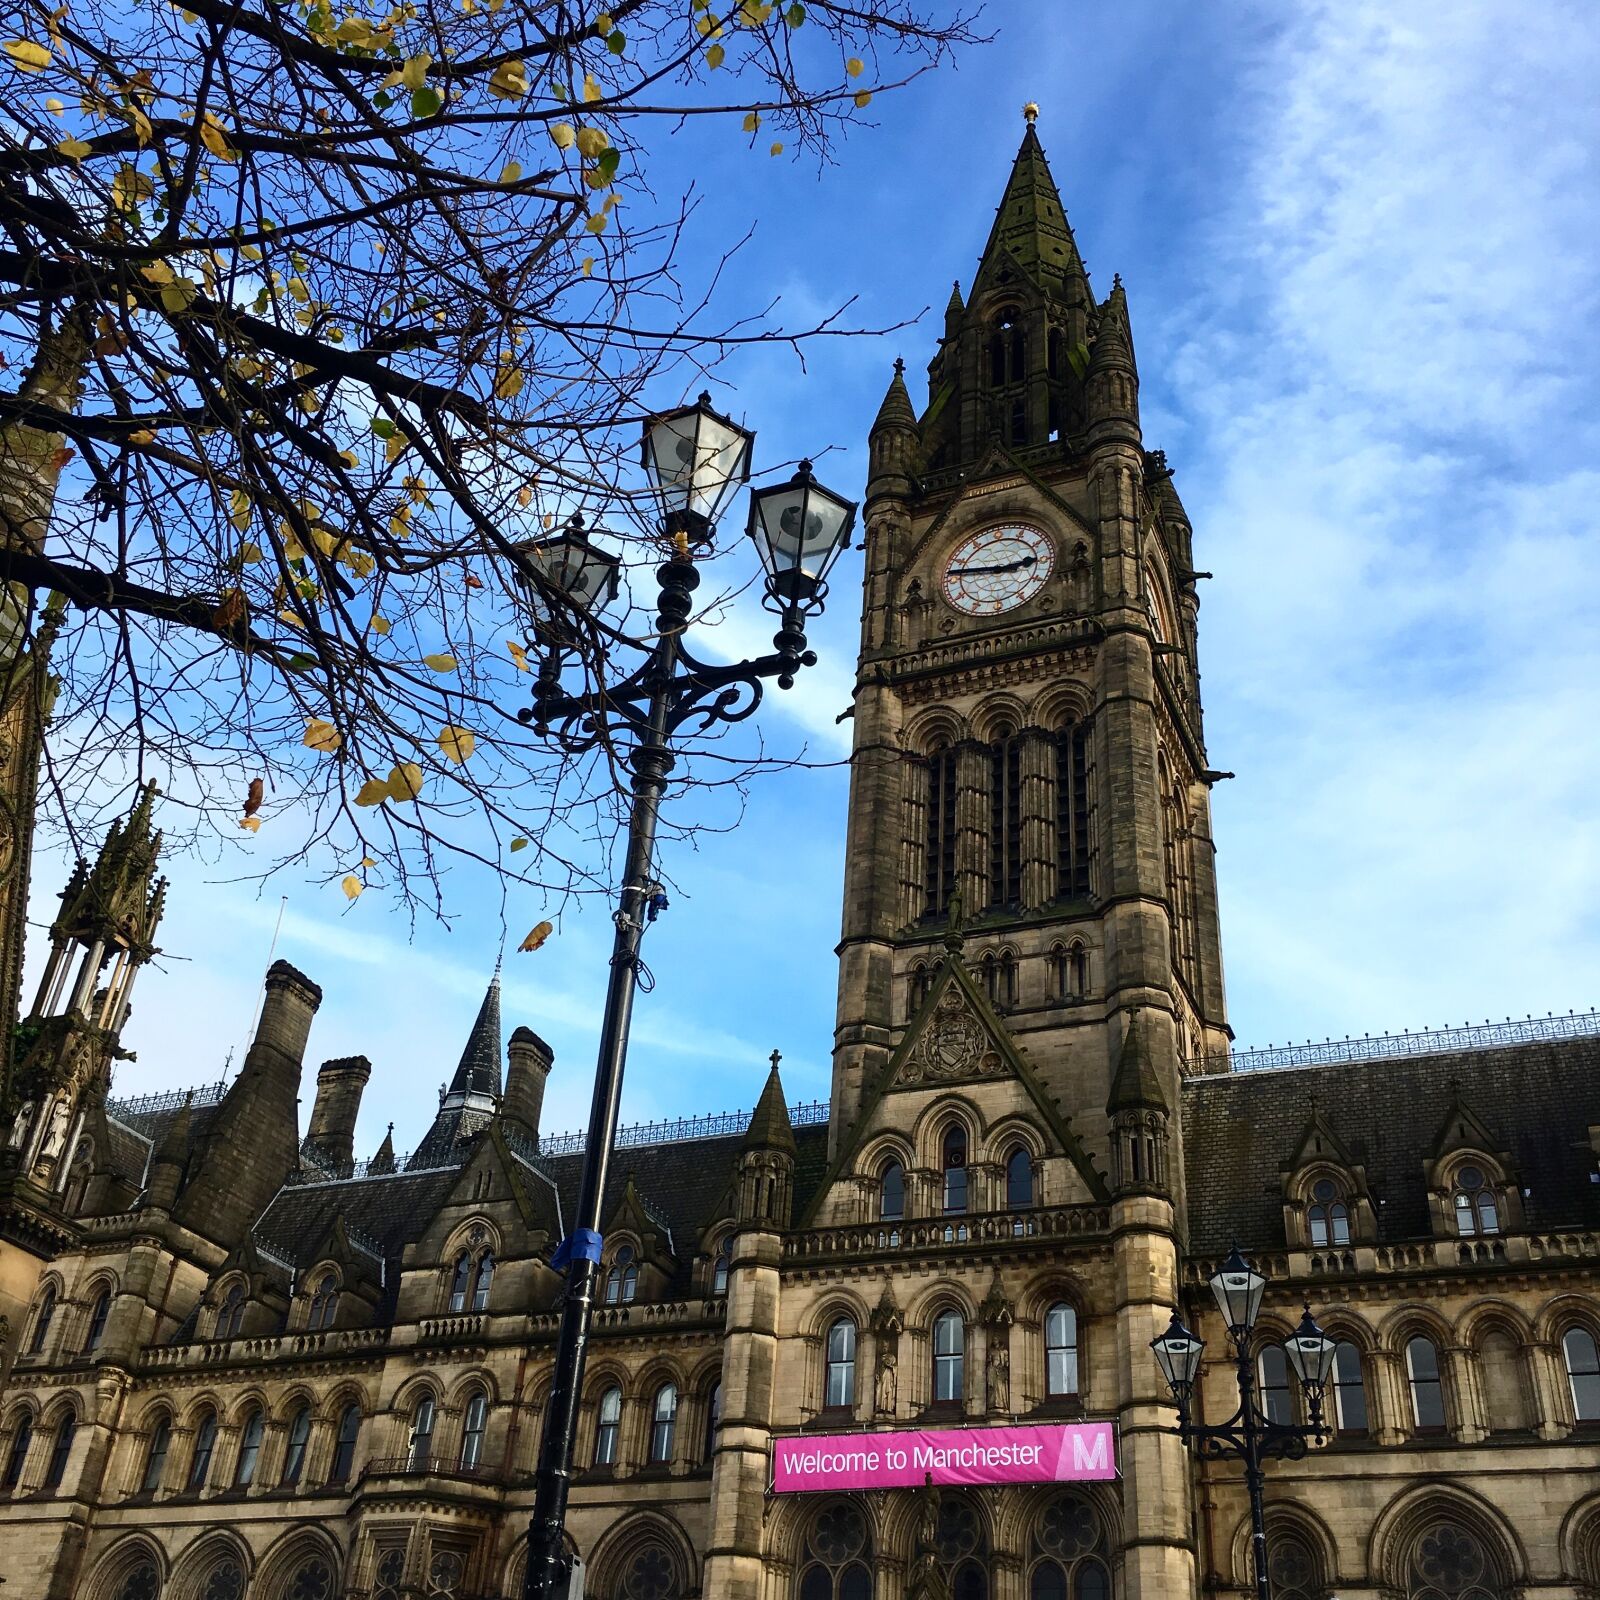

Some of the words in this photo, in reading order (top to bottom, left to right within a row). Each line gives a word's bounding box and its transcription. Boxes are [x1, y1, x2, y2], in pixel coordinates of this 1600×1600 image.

[783, 1449, 879, 1474] Welcome
[885, 1448, 907, 1469] to
[913, 1442, 1043, 1469] Manchester
[1073, 1432, 1108, 1470] M
